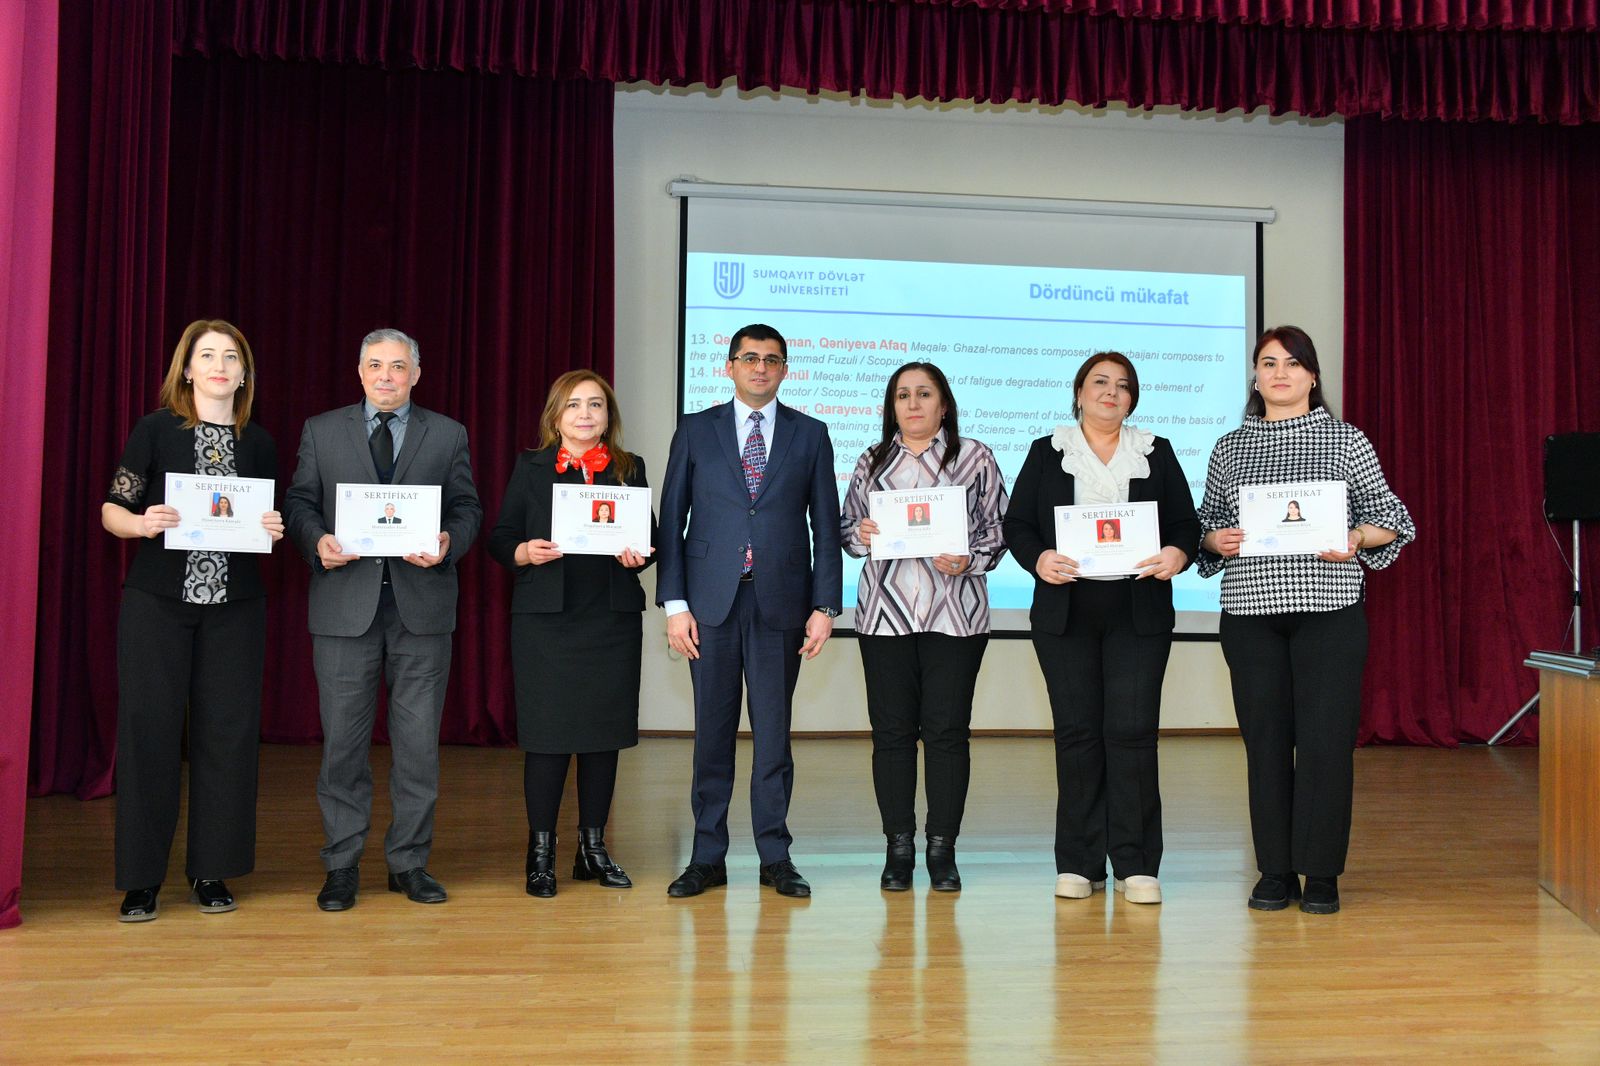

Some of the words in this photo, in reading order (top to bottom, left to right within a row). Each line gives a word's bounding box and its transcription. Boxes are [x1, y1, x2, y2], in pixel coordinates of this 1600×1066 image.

[753, 269, 815, 281] SUMQAYIT
[818, 270, 865, 282] DÖVLƏT
[770, 284, 849, 296] UNİVERSİTETİ
[1029, 283, 1115, 302] Dördüncü
[1120, 288, 1190, 305] mükafat
[691, 333, 709, 345] 13.
[819, 337, 877, 352] Qəniyeva
[879, 339, 908, 353] Afaq
[910, 342, 950, 354] Məqalə:
[953, 343, 1039, 356] Ghazal-romances
[1041, 347, 1091, 358] composed
[1162, 351, 1213, 363] composers
[1215, 352, 1225, 362] to
[689, 351, 707, 361] the
[786, 354, 826, 365] ammad
[827, 354, 858, 365] Fuzuli
[867, 356, 904, 368] Scopus
[689, 367, 708, 378] 14.
[813, 371, 854, 383] Məqalə:
[957, 376, 968, 386] of
[969, 376, 1003, 387] fatigue
[1005, 377, 1063, 389] degradation
[688, 384, 719, 394] linear
[781, 386, 812, 397] motor
[821, 387, 859, 398] Scopus
[1154, 381, 1192, 392] element
[1194, 383, 1205, 393] of
[814, 403, 873, 417] Qarayeva
[975, 408, 1039, 420] Development
[1041, 409, 1051, 420] of
[1156, 414, 1169, 424] on
[1171, 414, 1187, 424] the
[1188, 415, 1214, 425] basis
[1216, 415, 1226, 425] of
[964, 423, 976, 433] of
[977, 424, 1017, 435] Science
[1028, 425, 1042, 435] Q4
[1176, 446, 1201, 457] order
[195, 482, 252, 493] SERTİFİKAT
[364, 491, 419, 500] SERTİFİKAT
[579, 491, 631, 501] SERTİFİKAT
[1266, 489, 1323, 499] SERTİFİKAT
[1082, 509, 1136, 519] SERTİFİKAT
